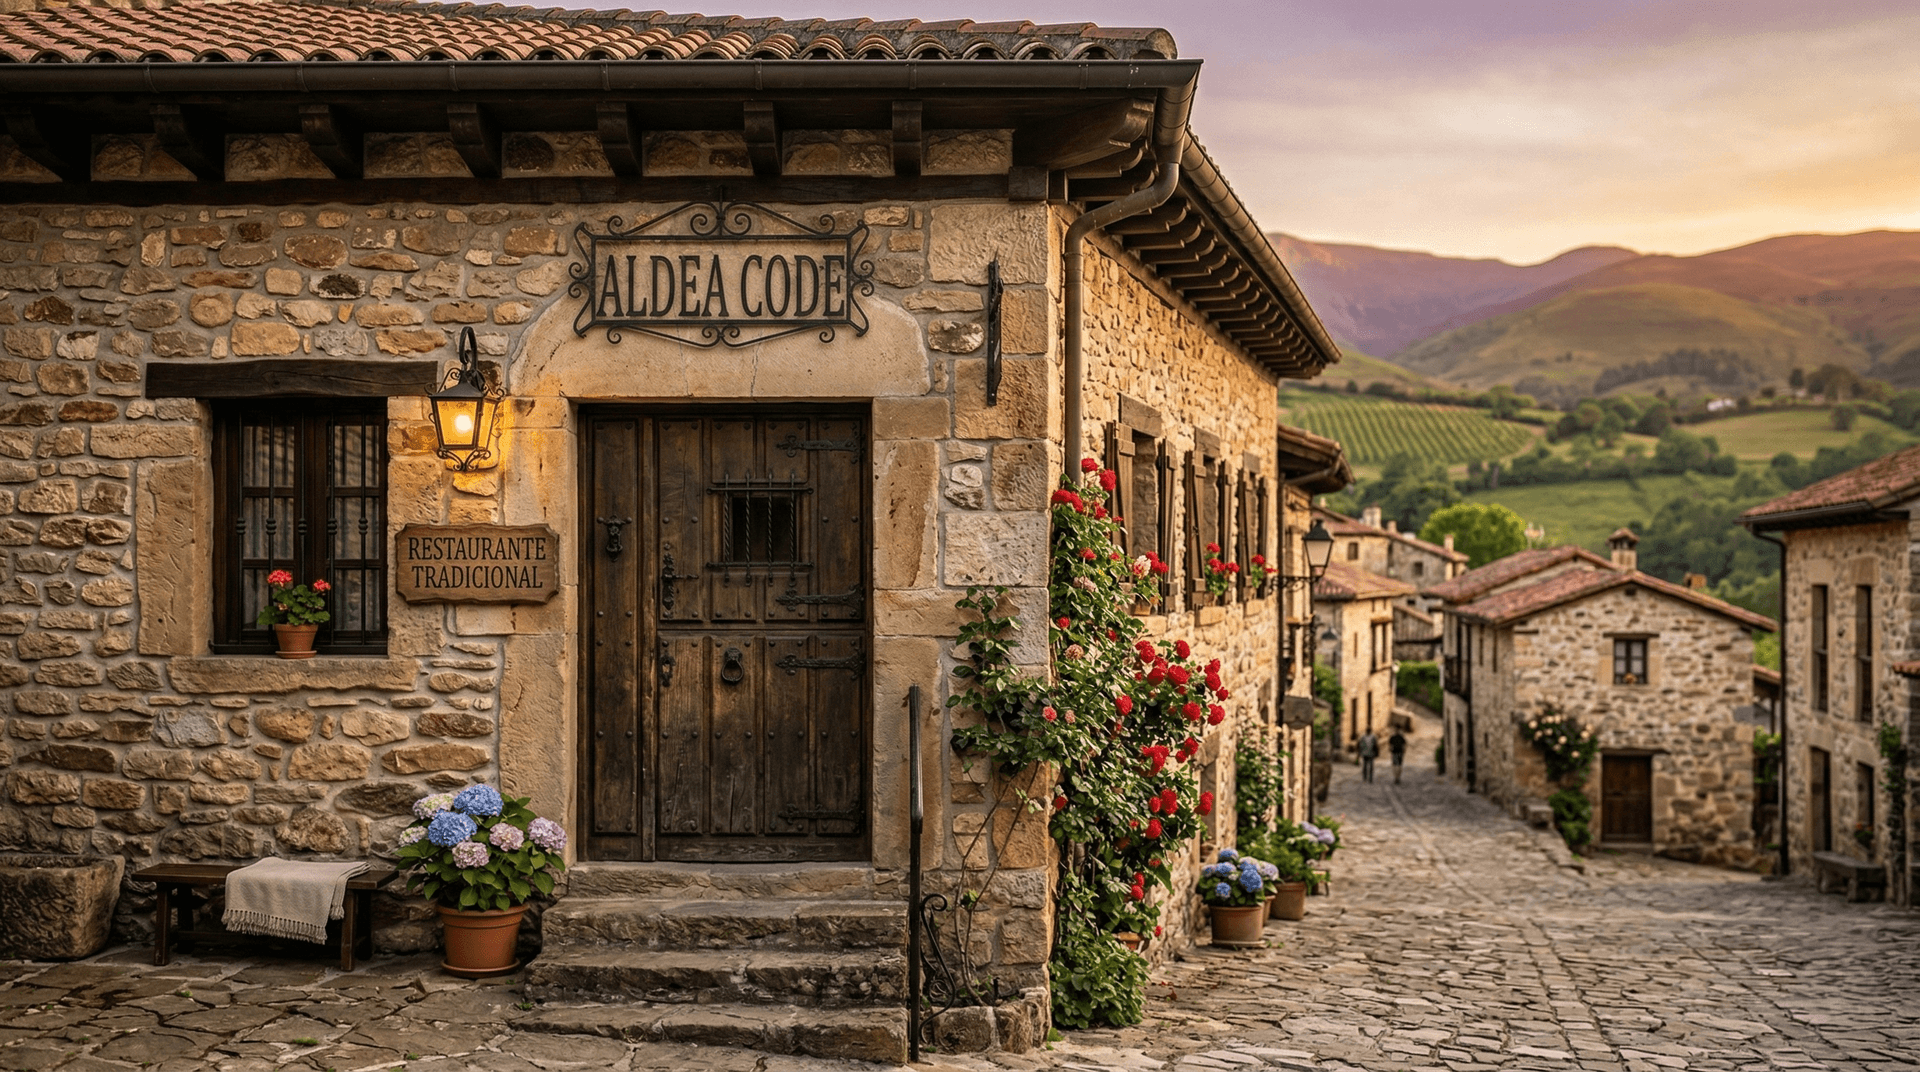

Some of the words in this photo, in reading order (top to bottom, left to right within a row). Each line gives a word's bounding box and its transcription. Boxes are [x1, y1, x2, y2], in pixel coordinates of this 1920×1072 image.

[596, 254, 729, 317] ALDEA
[740, 254, 846, 317] CODE
[408, 537, 546, 560] RESTAURANTE
[411, 565, 543, 588] TRADICIONAL
